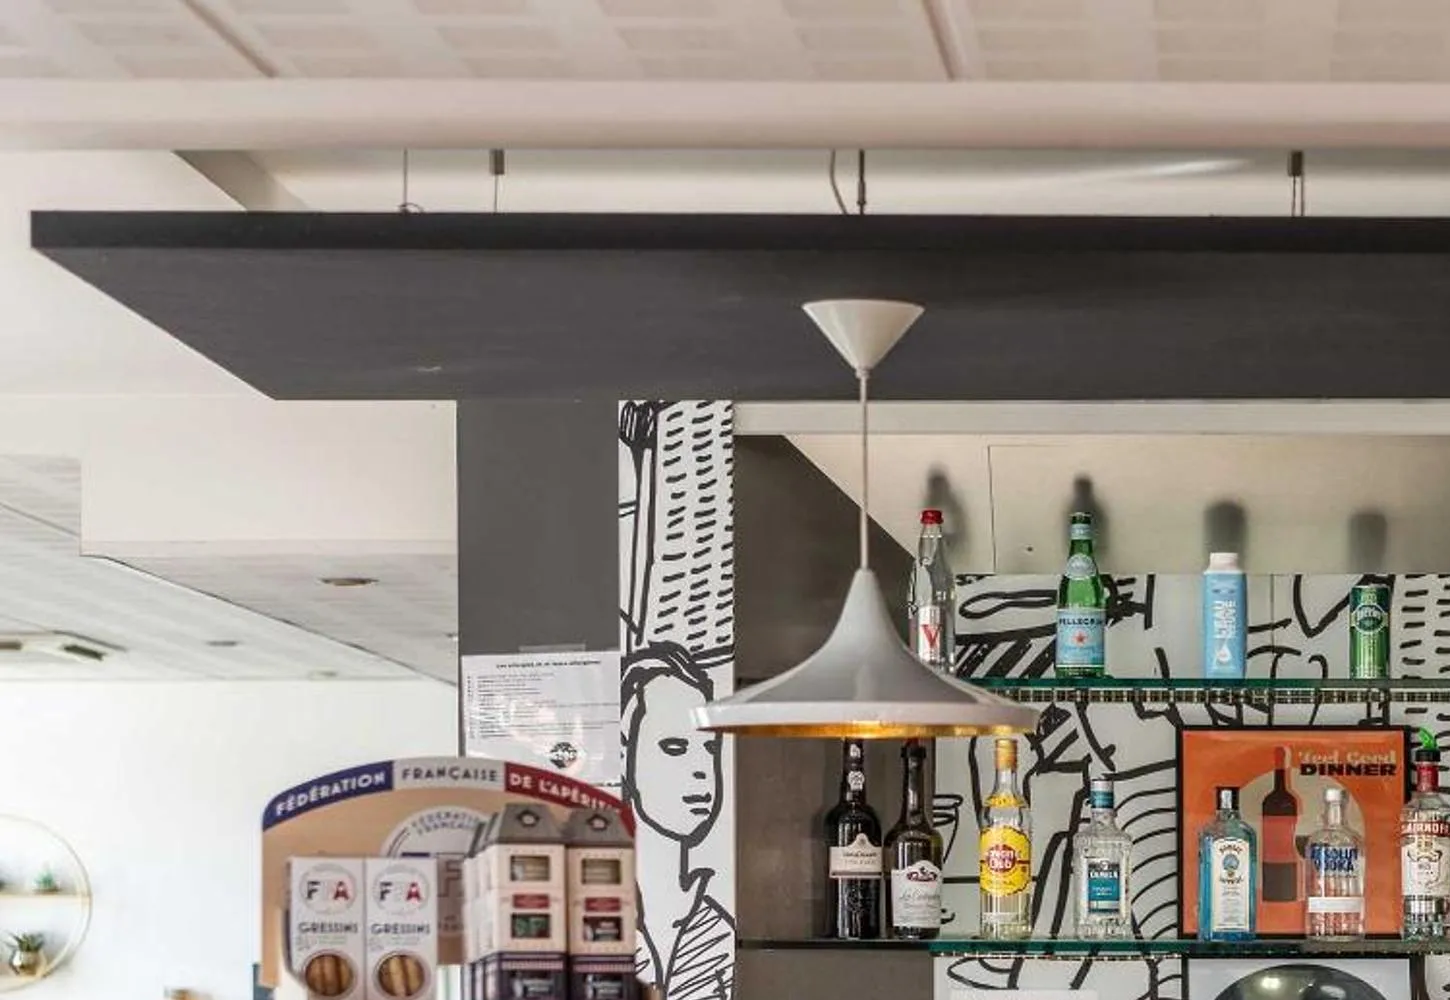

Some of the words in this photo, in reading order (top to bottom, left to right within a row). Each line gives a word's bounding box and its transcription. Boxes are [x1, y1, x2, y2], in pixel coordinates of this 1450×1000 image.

[1300, 763, 1397, 776] DINNER
[275, 771, 386, 816] FÉDÉRATION
[402, 768, 498, 782] FRANÇAISE
[509, 773, 532, 789] DE
